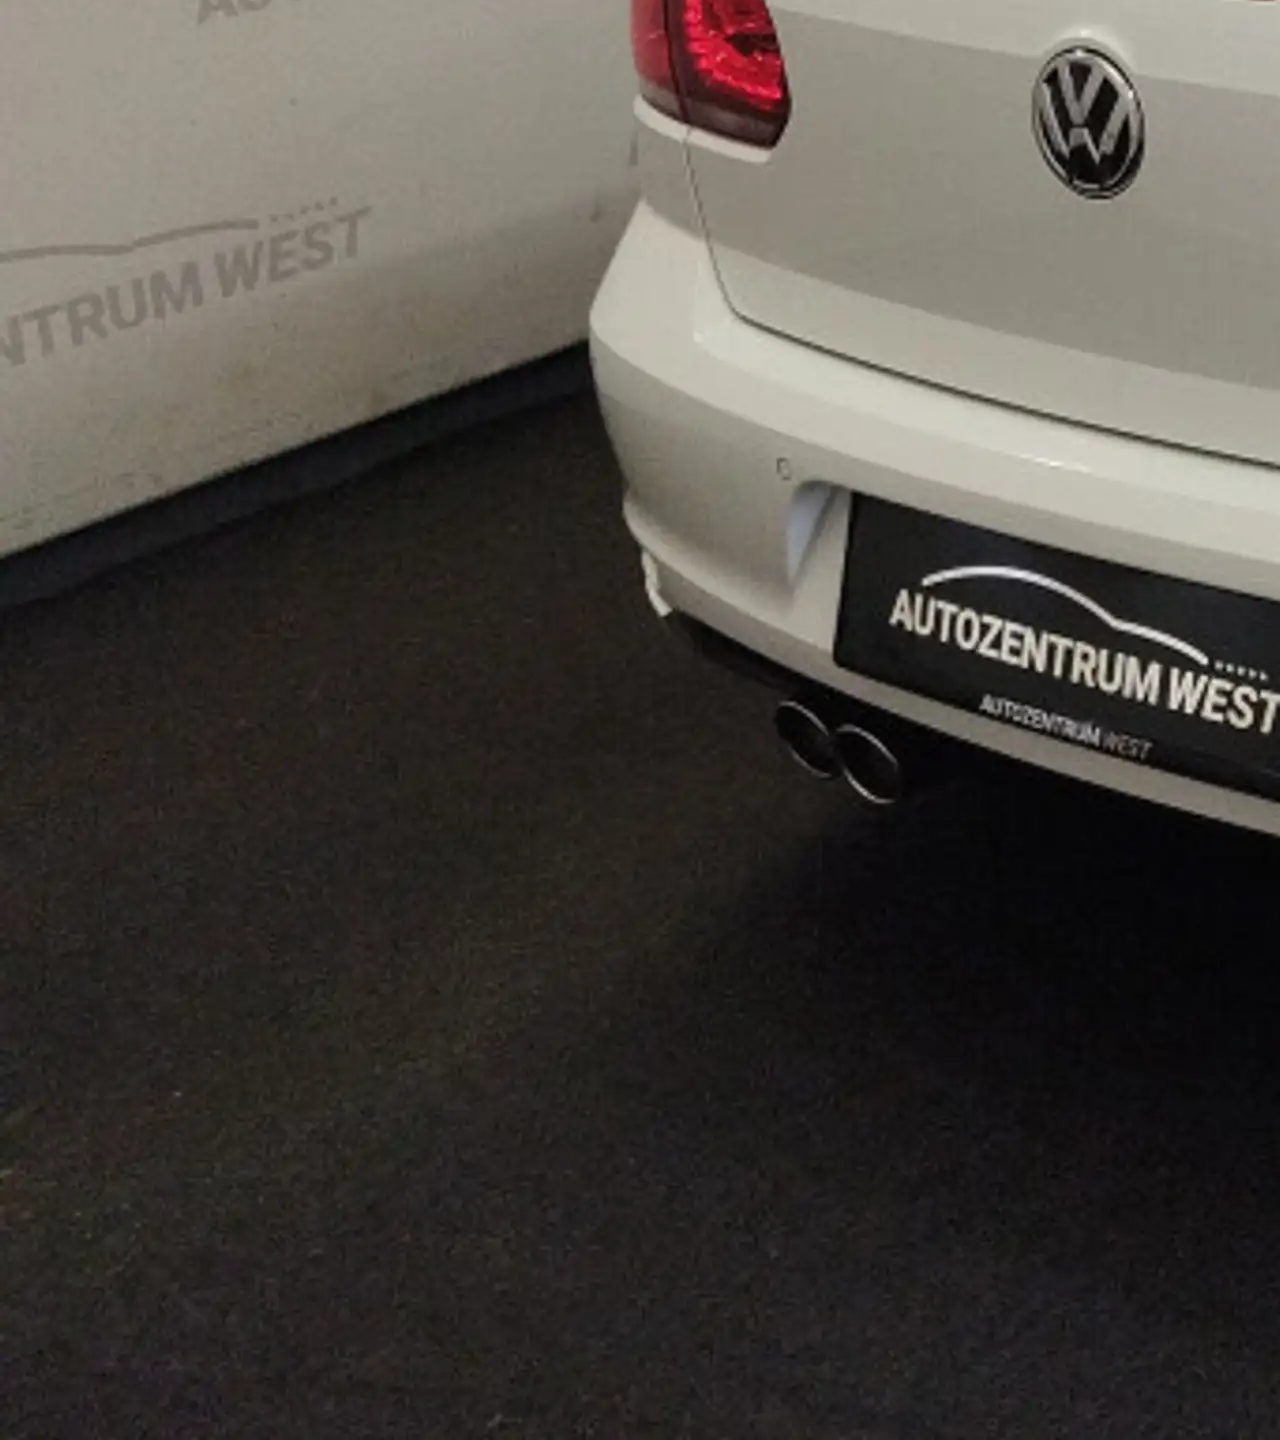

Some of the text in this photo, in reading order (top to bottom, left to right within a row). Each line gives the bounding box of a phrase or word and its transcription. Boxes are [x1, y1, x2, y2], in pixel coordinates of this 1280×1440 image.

[1036, 53, 1139, 184] VW
[213, 205, 372, 298] WEST
[889, 589, 1161, 706] AUTOZENTRUM
[979, 693, 1154, 760] AUTOZENTRUM WEST
